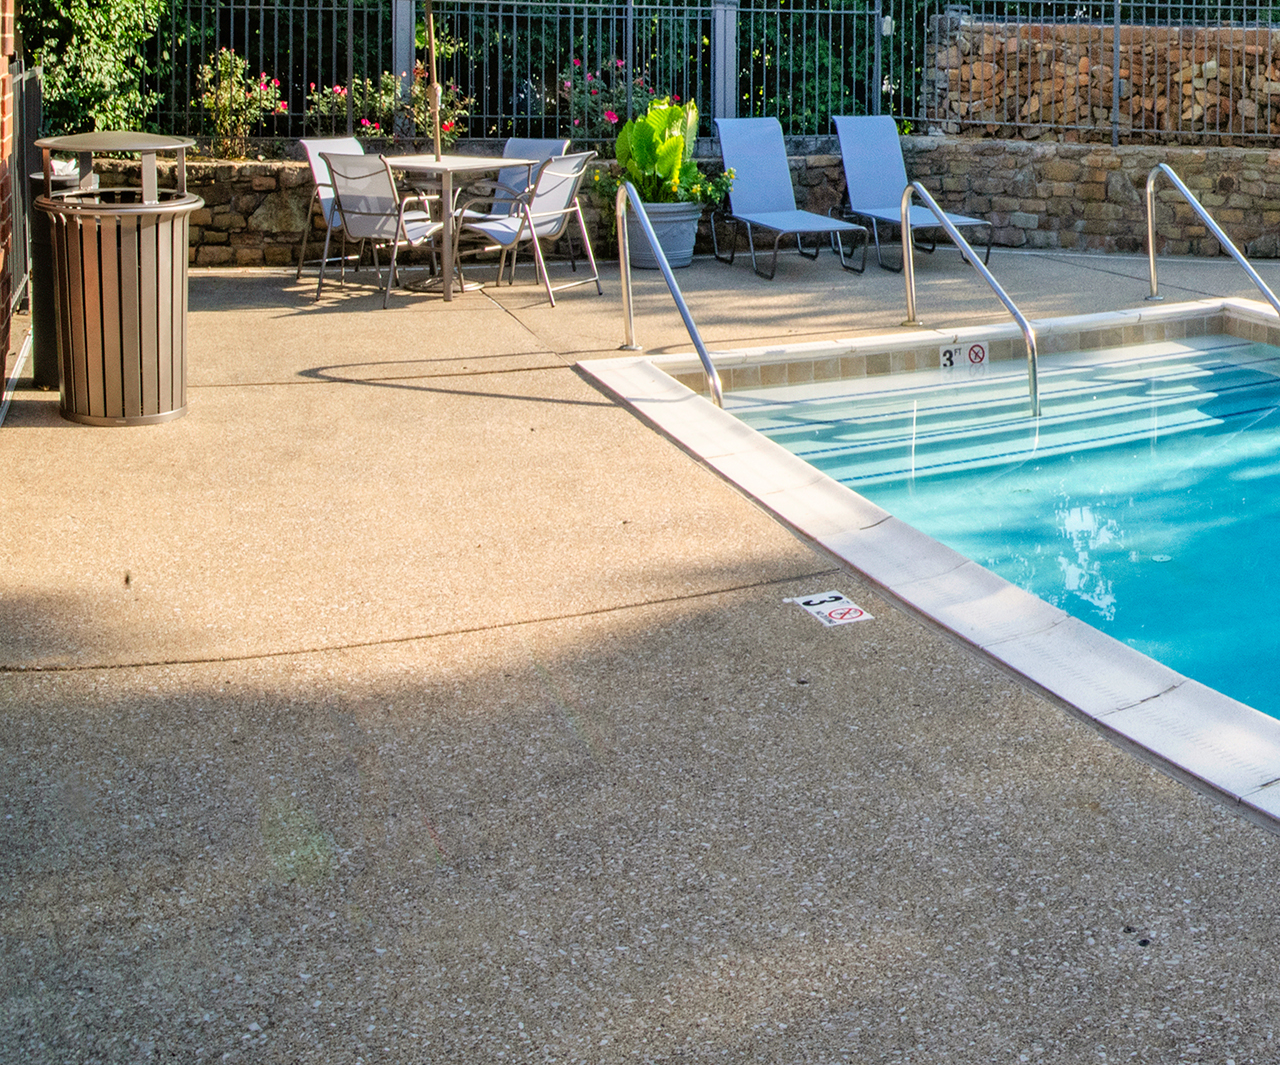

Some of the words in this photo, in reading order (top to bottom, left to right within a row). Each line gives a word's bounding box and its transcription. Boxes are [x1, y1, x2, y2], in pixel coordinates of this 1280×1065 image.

[942, 349, 954, 367] 3
[954, 347, 962, 356] FT
[802, 595, 843, 606] 3
